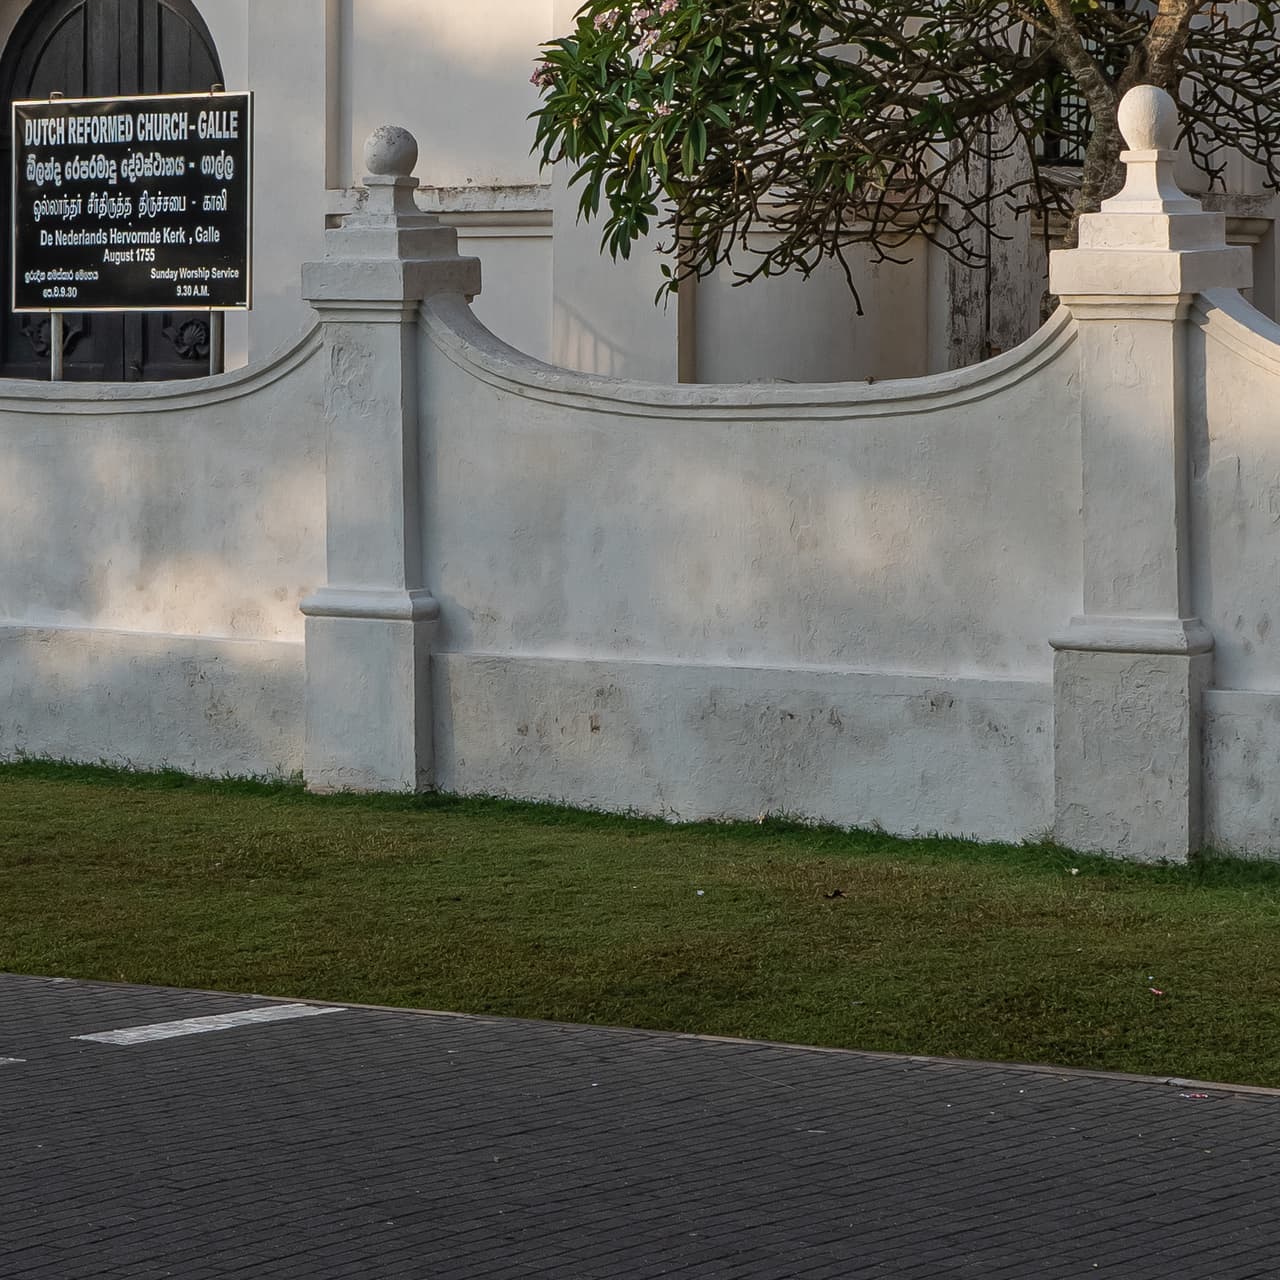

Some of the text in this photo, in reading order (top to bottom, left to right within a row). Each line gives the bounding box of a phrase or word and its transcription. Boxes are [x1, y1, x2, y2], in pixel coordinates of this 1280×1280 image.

[24, 118, 65, 146] DUTCH
[68, 114, 134, 144] REFORMED
[136, 111, 188, 141] CHURCH
[198, 110, 239, 140] GALLE
[138, 189, 187, 219] திருச்சபை
[202, 188, 228, 212] காலி
[40, 230, 54, 247] De
[55, 228, 108, 246] Nederlands
[109, 227, 162, 245] Hervormde
[163, 226, 186, 244] Kerk
[195, 225, 221, 243] Galle
[103, 247, 156, 266] August 1755
[150, 266, 240, 281] Sunday Worship Service
[176, 284, 210, 296] 9.30 A.M.
